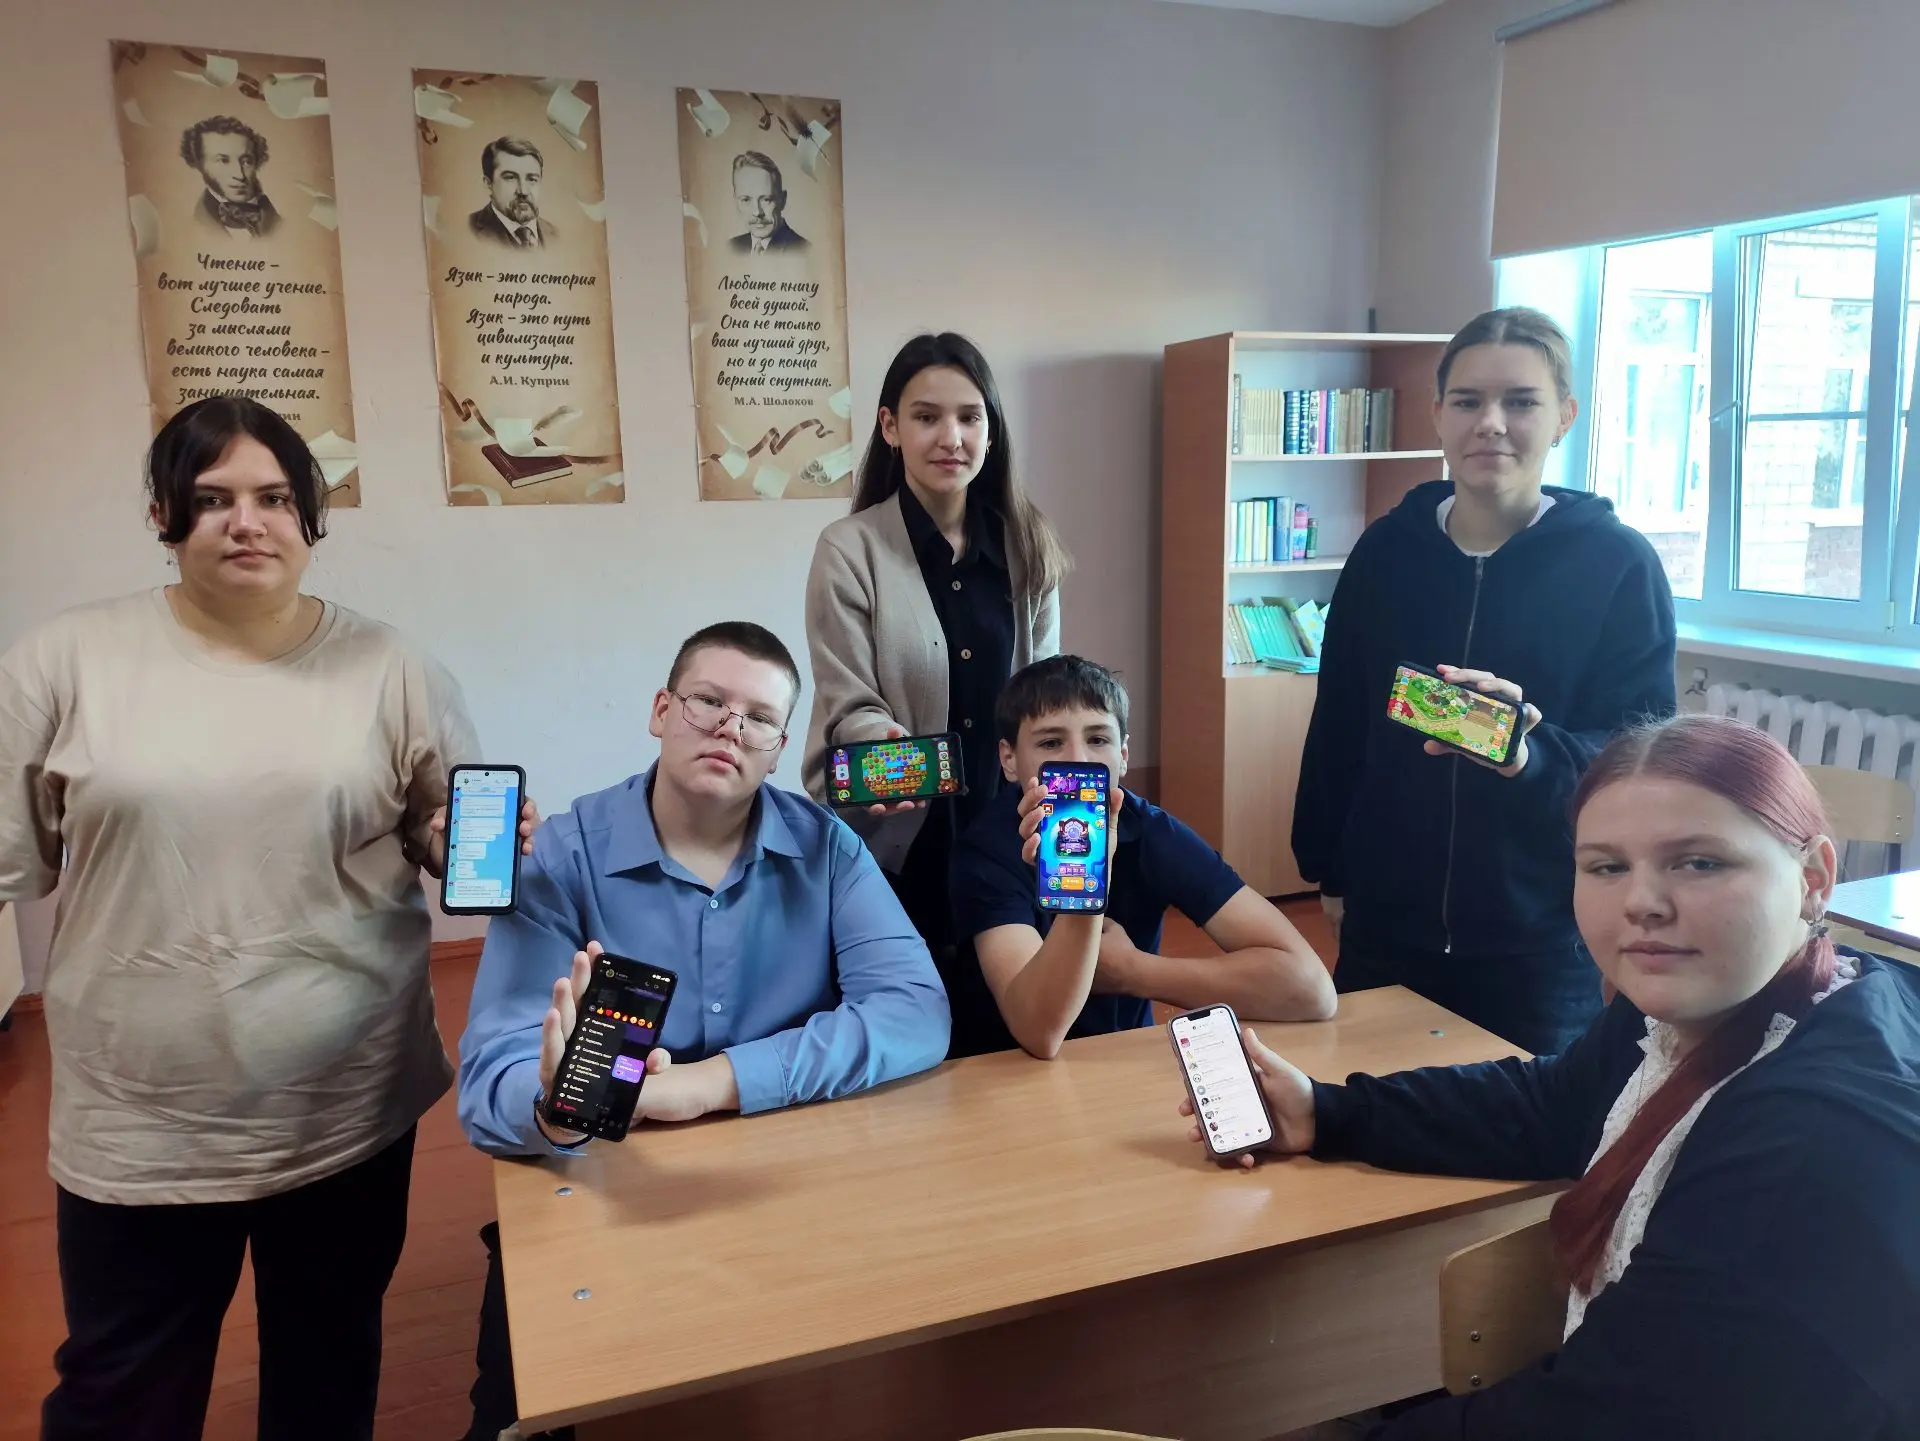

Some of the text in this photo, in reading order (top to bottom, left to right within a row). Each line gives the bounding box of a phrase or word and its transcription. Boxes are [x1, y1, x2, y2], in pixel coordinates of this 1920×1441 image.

[197, 252, 265, 271] Чтение
[158, 272, 327, 299] вот лучшее учение.
[444, 266, 483, 287] Язык
[498, 272, 527, 283] это
[531, 273, 596, 291] история
[718, 274, 819, 298] Любите книгу
[190, 296, 282, 319] Следовать
[493, 292, 551, 310] народа.
[730, 293, 809, 316] всей душой.
[466, 308, 503, 329] Язык
[519, 313, 549, 325] это
[553, 315, 591, 331] путь
[720, 314, 821, 331] Она не только
[185, 322, 291, 340] за мыслями
[477, 328, 574, 350] цивилизации
[166, 338, 240, 356] великого
[246, 340, 317, 358] человека
[711, 332, 830, 355] ваш лучший друг,
[481, 353, 573, 370] и культуры.
[726, 358, 818, 373] но и до конца
[172, 366, 324, 383] есть наука самая
[489, 376, 570, 388] А.И. Куприн
[716, 371, 832, 392] верный спутник.
[734, 397, 814, 406] М.А. Шолохов
